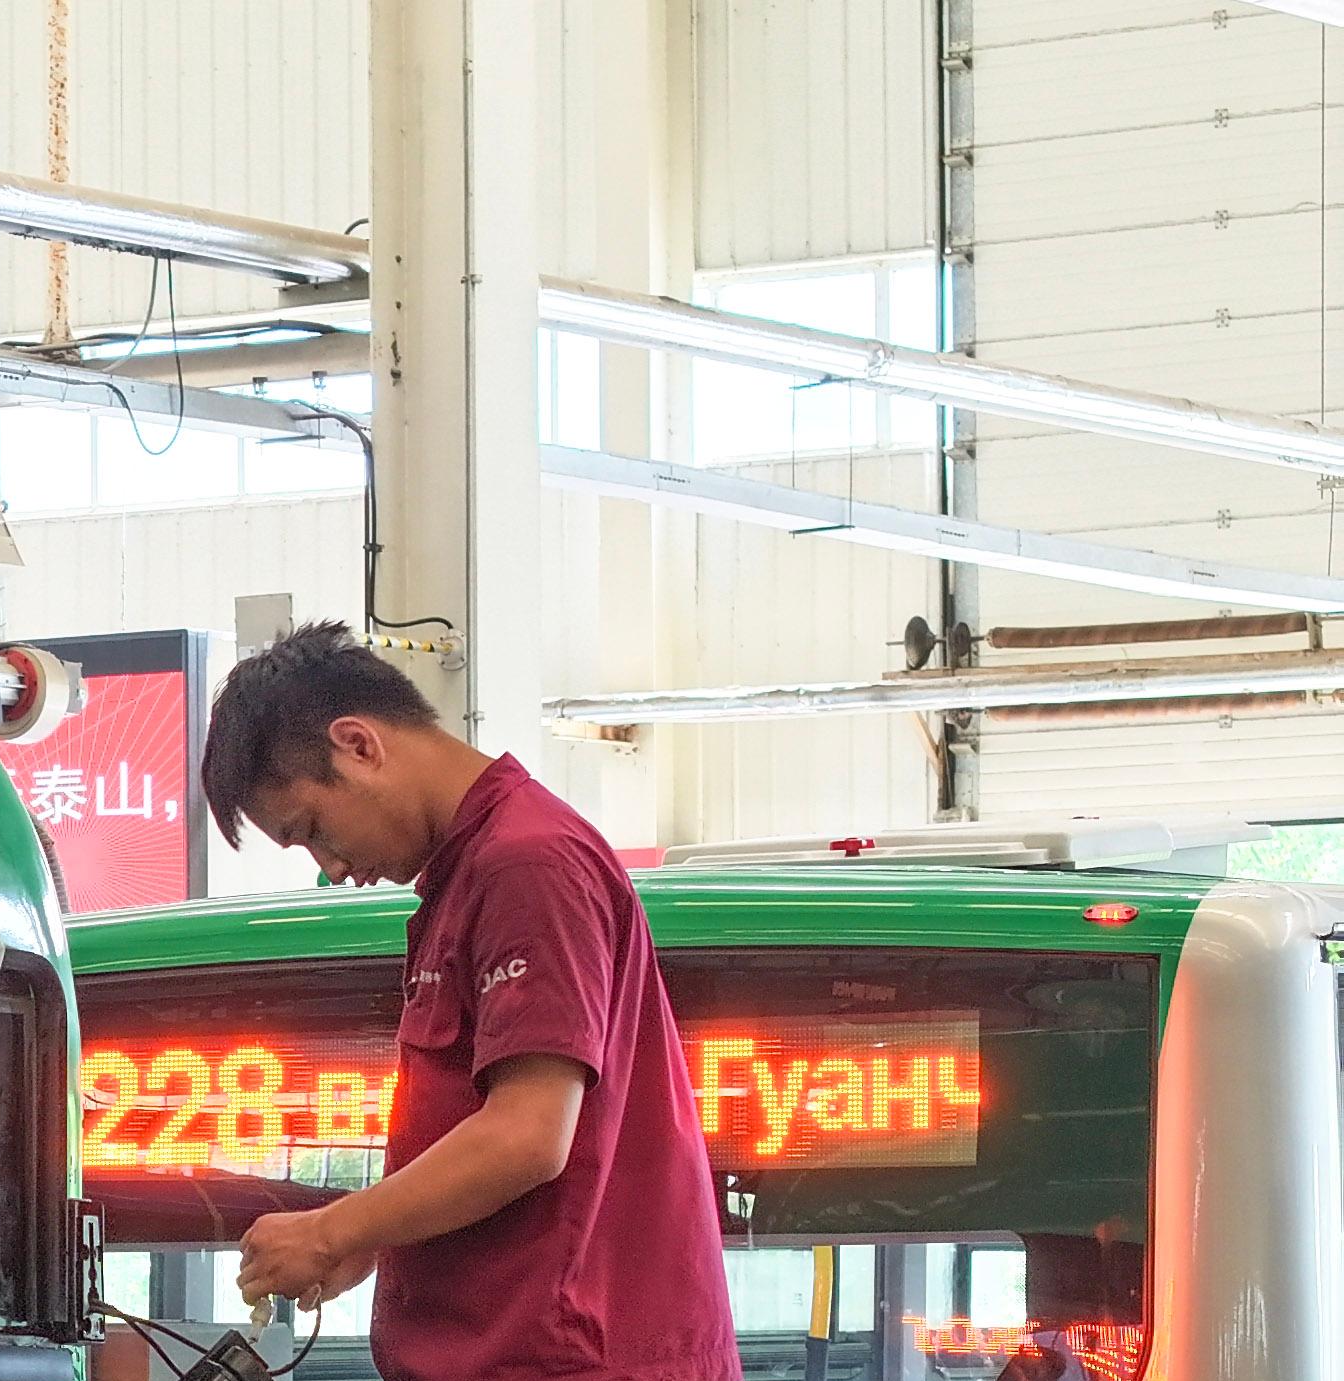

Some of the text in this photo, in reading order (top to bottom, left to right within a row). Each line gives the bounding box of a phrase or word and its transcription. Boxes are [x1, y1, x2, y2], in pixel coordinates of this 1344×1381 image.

[9, 761, 179, 824] 泰山，
[481, 958, 528, 994] JAC
[80, 1046, 283, 1166] 228
